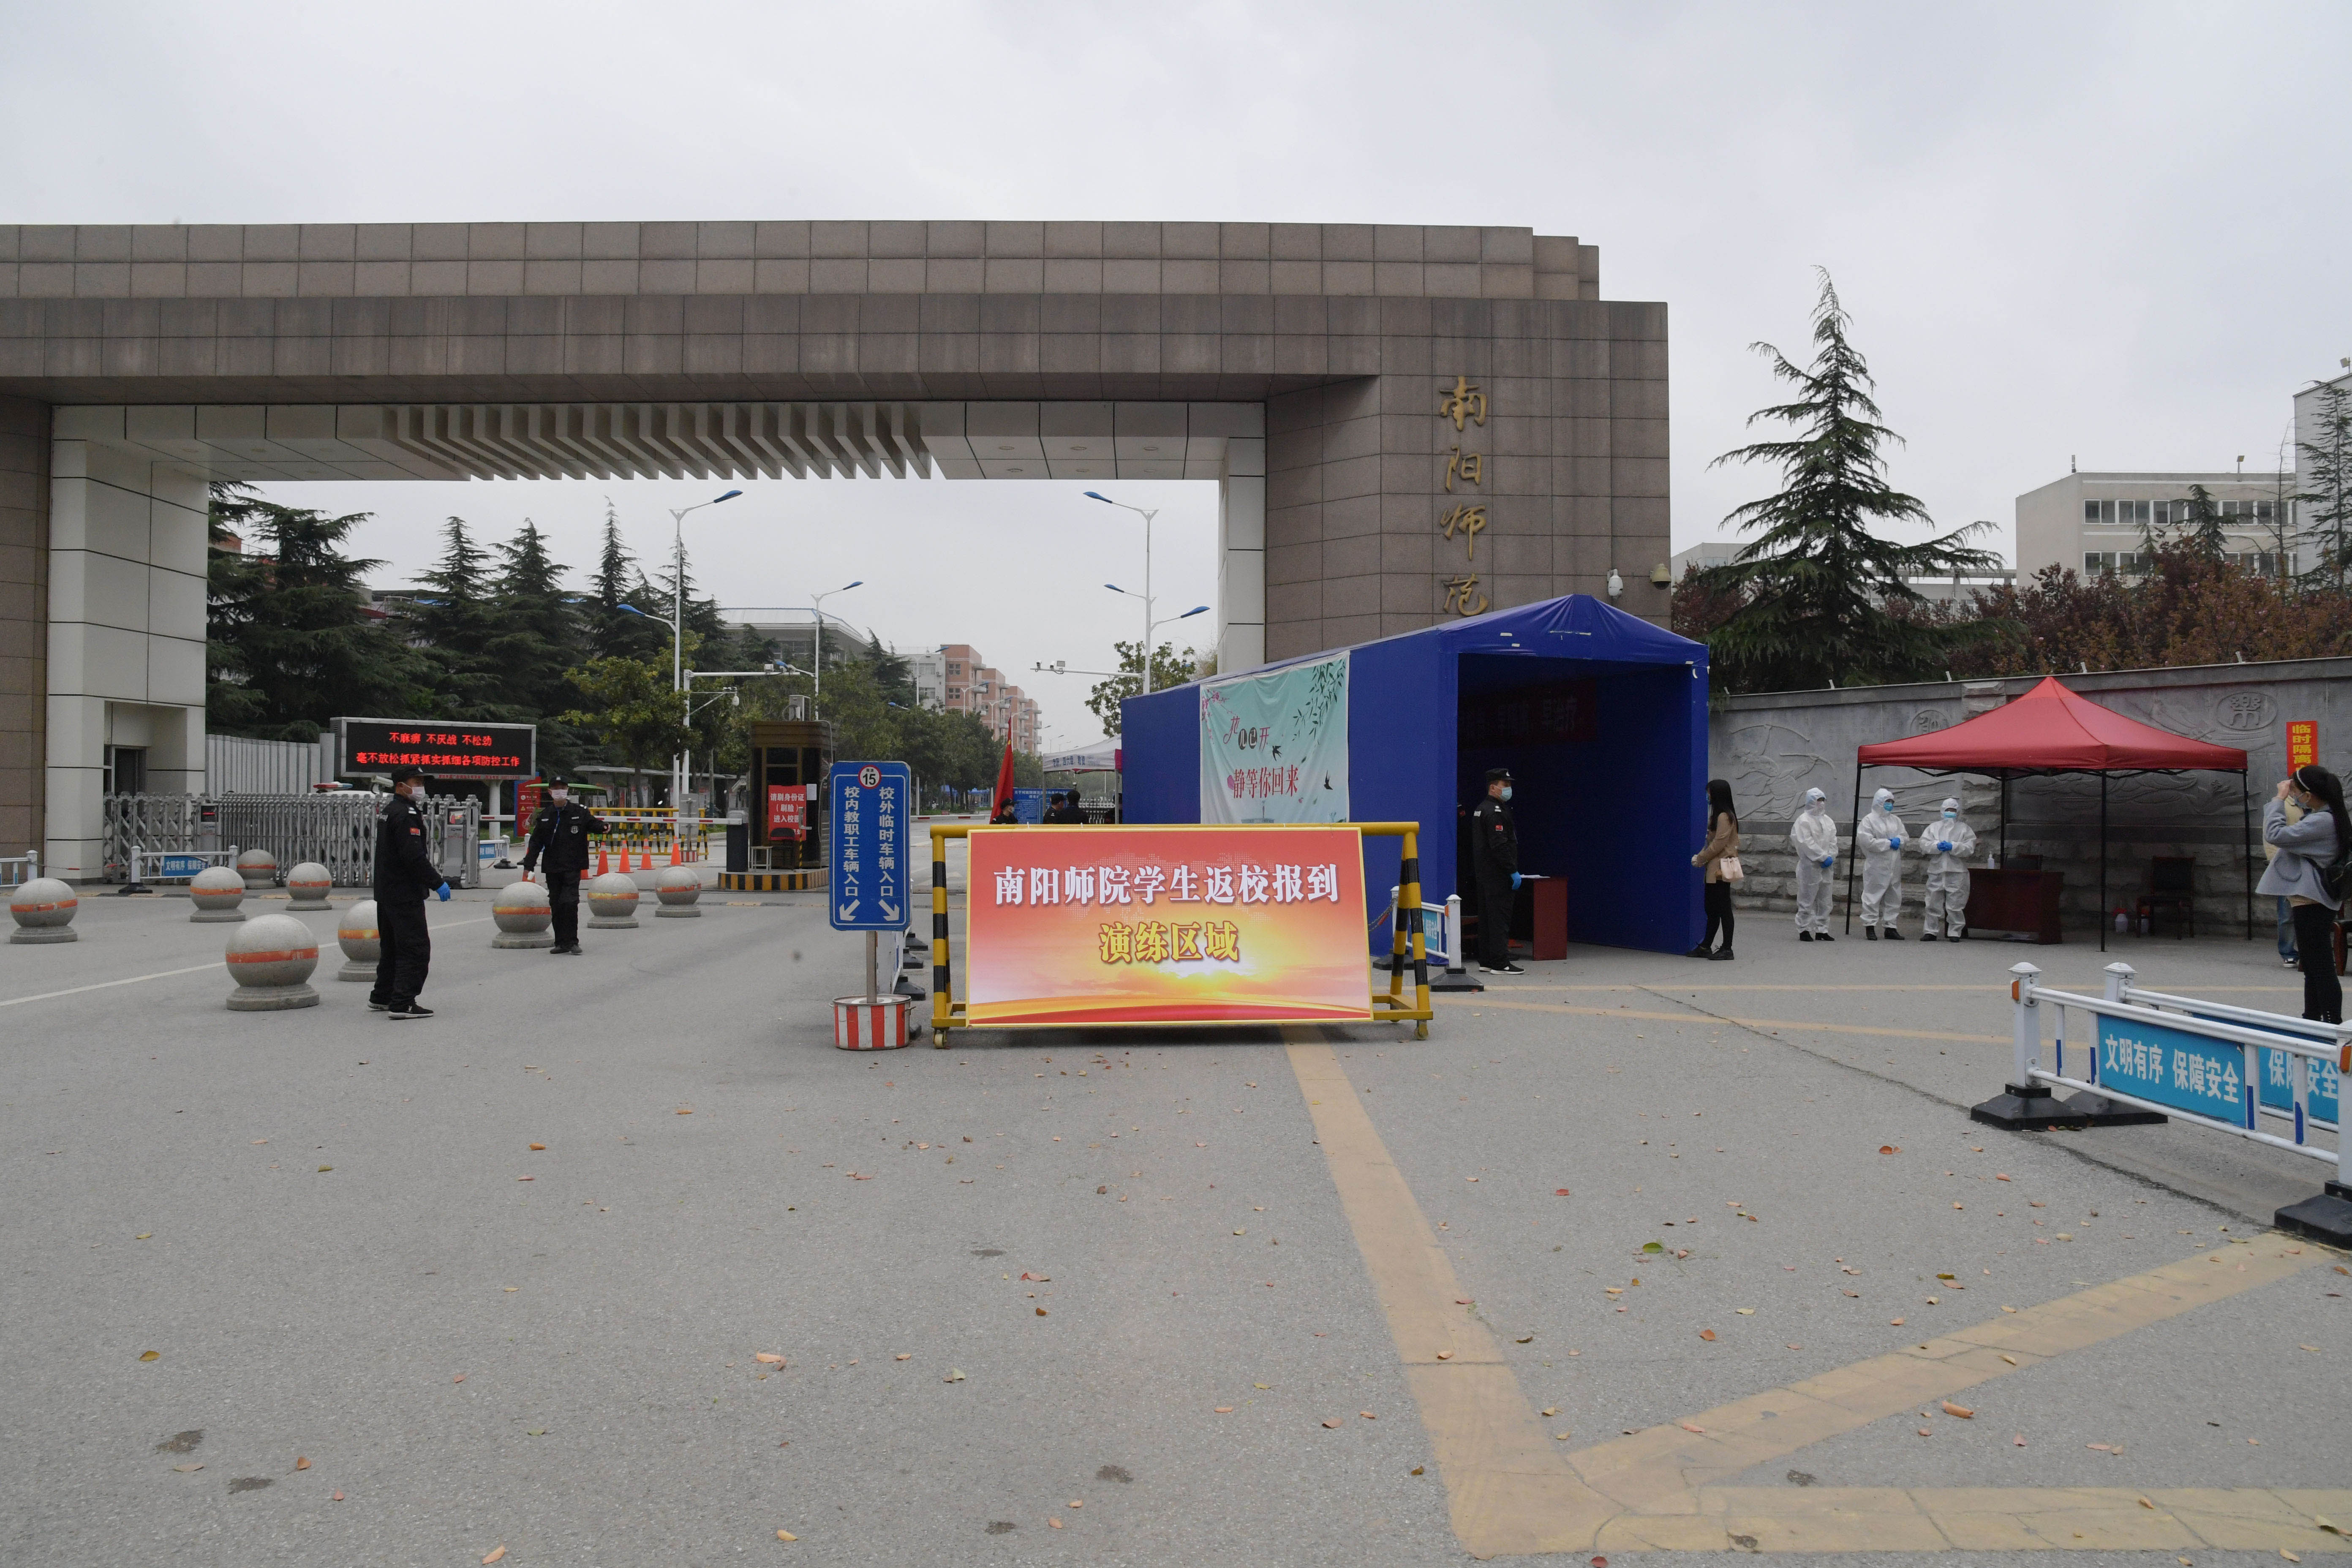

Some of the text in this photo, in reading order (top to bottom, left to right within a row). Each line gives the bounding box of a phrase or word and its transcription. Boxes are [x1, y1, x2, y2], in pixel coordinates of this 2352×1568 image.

[1440, 375, 1488, 616] 南阳师范
[356, 752, 520, 767] 毫不放松抓紧抓实抓细各项防控工作
[389, 732, 492, 746] 不麻痹 不厌战 不松劲
[2292, 724, 2312, 771] 临时隔离
[863, 773, 876, 785] 15
[1233, 765, 1299, 798] 静等你回来
[844, 786, 860, 896] 校内教职工车辆入口
[879, 787, 895, 897] 校外临时车辆入口
[994, 863, 1338, 905] 南阳师院学生返校报到
[1098, 921, 1239, 964] 演练区域
[2105, 1034, 2239, 1103] 文明有序 保障安全
